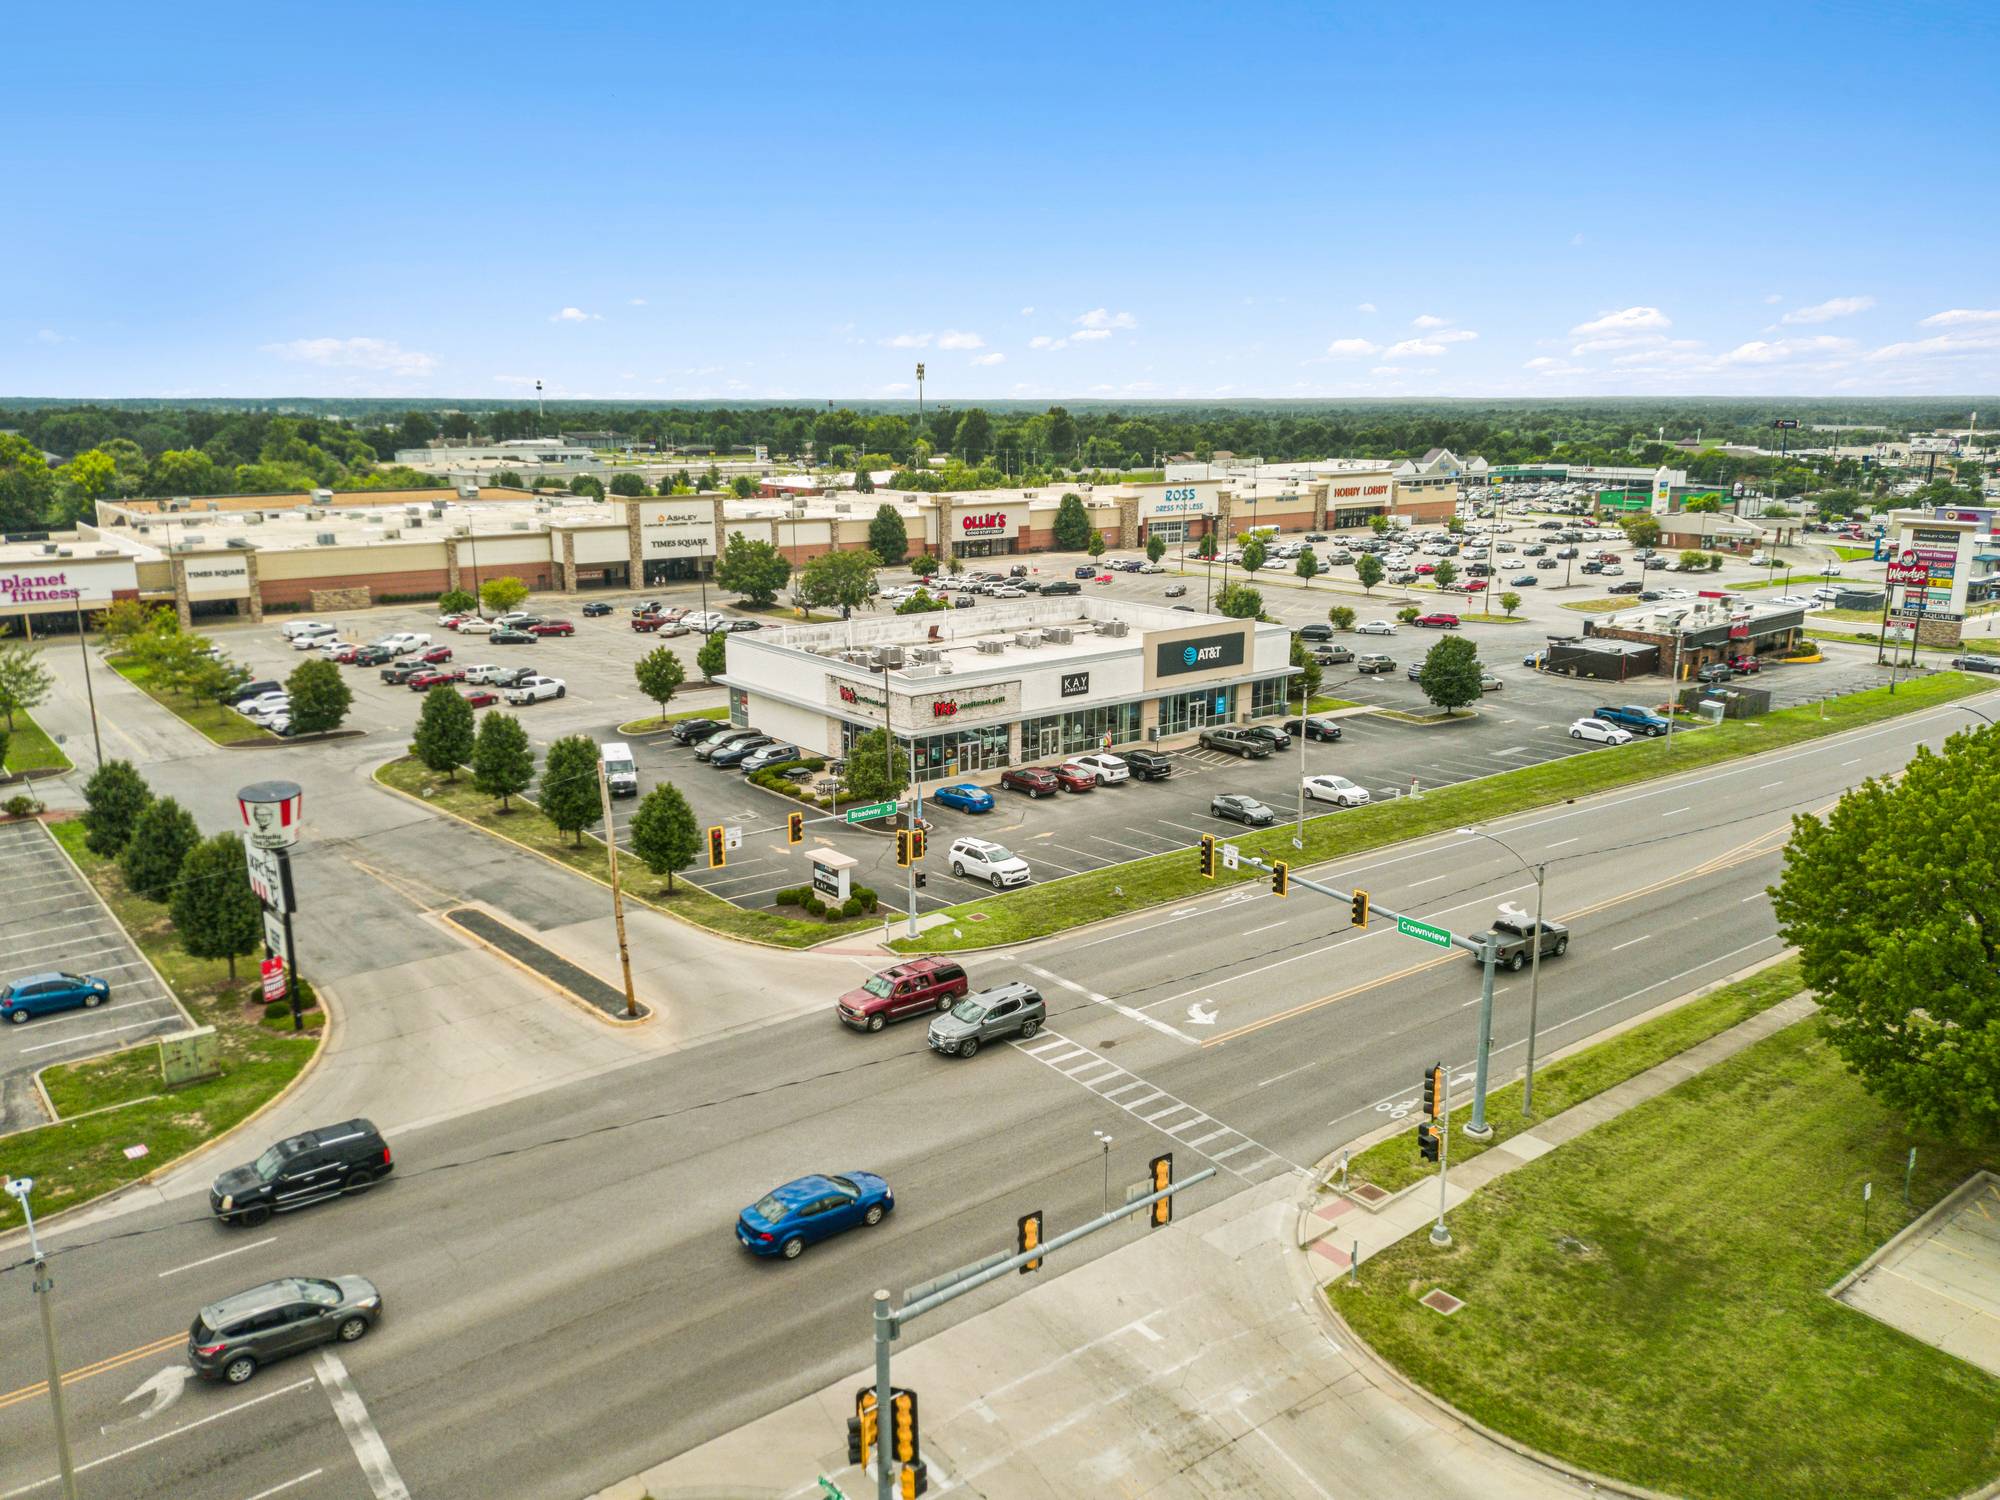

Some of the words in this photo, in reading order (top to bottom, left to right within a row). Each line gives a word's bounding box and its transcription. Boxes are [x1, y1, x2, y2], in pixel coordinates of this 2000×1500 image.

[1165, 488, 1196, 501] ROSS
[1334, 486, 1360, 497] HOBBY
[1363, 485, 1388, 496] LOBBY
[651, 539, 676, 548] TIMES
[677, 538, 709, 548] SQUARE
[214, 568, 246, 578] SQUARE
[1888, 567, 1926, 581] Wendy's
[1, 572, 66, 593] planet
[11, 588, 80, 602] fitness
[1894, 609, 1919, 617] TMES
[1922, 612, 1956, 621] SQUARE
[1197, 645, 1222, 662] AT&T
[1064, 676, 1088, 688] KAY
[851, 807, 882, 819] Broadway
[886, 803, 893, 812] St
[1401, 920, 1448, 943] Crownview
